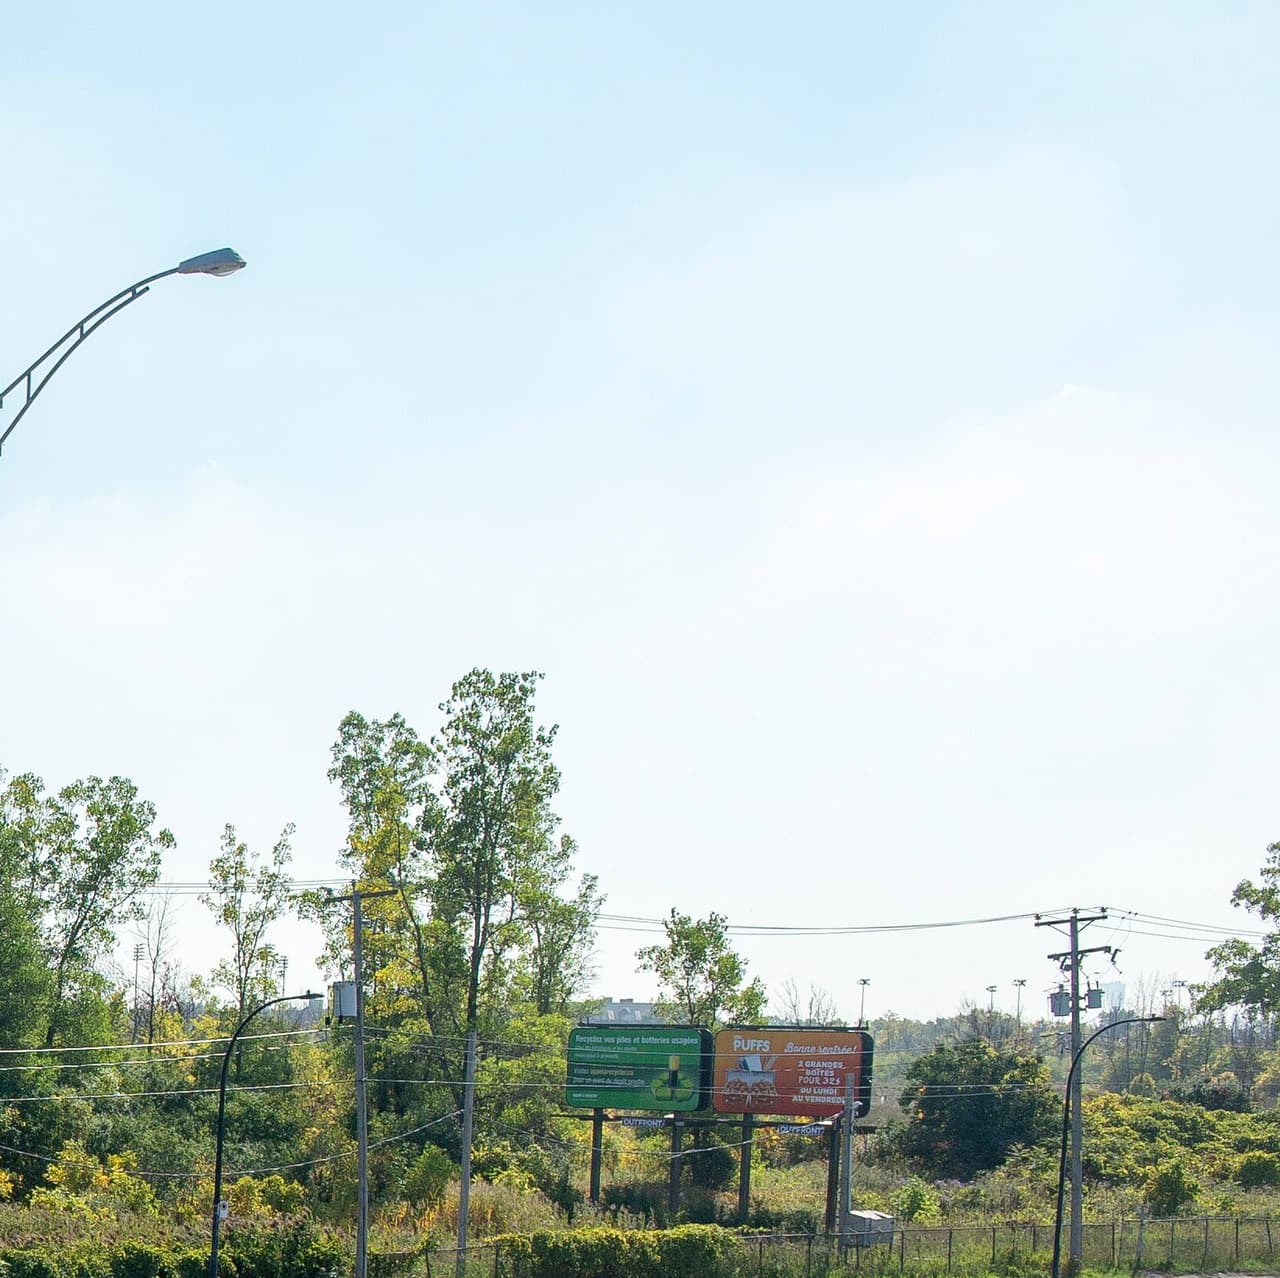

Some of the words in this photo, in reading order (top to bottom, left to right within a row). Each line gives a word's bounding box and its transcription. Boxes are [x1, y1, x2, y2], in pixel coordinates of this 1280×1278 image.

[616, 1036, 631, 1045] piles
[641, 1036, 670, 1044] batteries
[733, 1038, 770, 1053] PUFFS
[784, 1041, 817, 1053] Bonne
[805, 1060, 843, 1069] GRANDES
[798, 1076, 821, 1085] POUR
[813, 1087, 837, 1095] LUNDI
